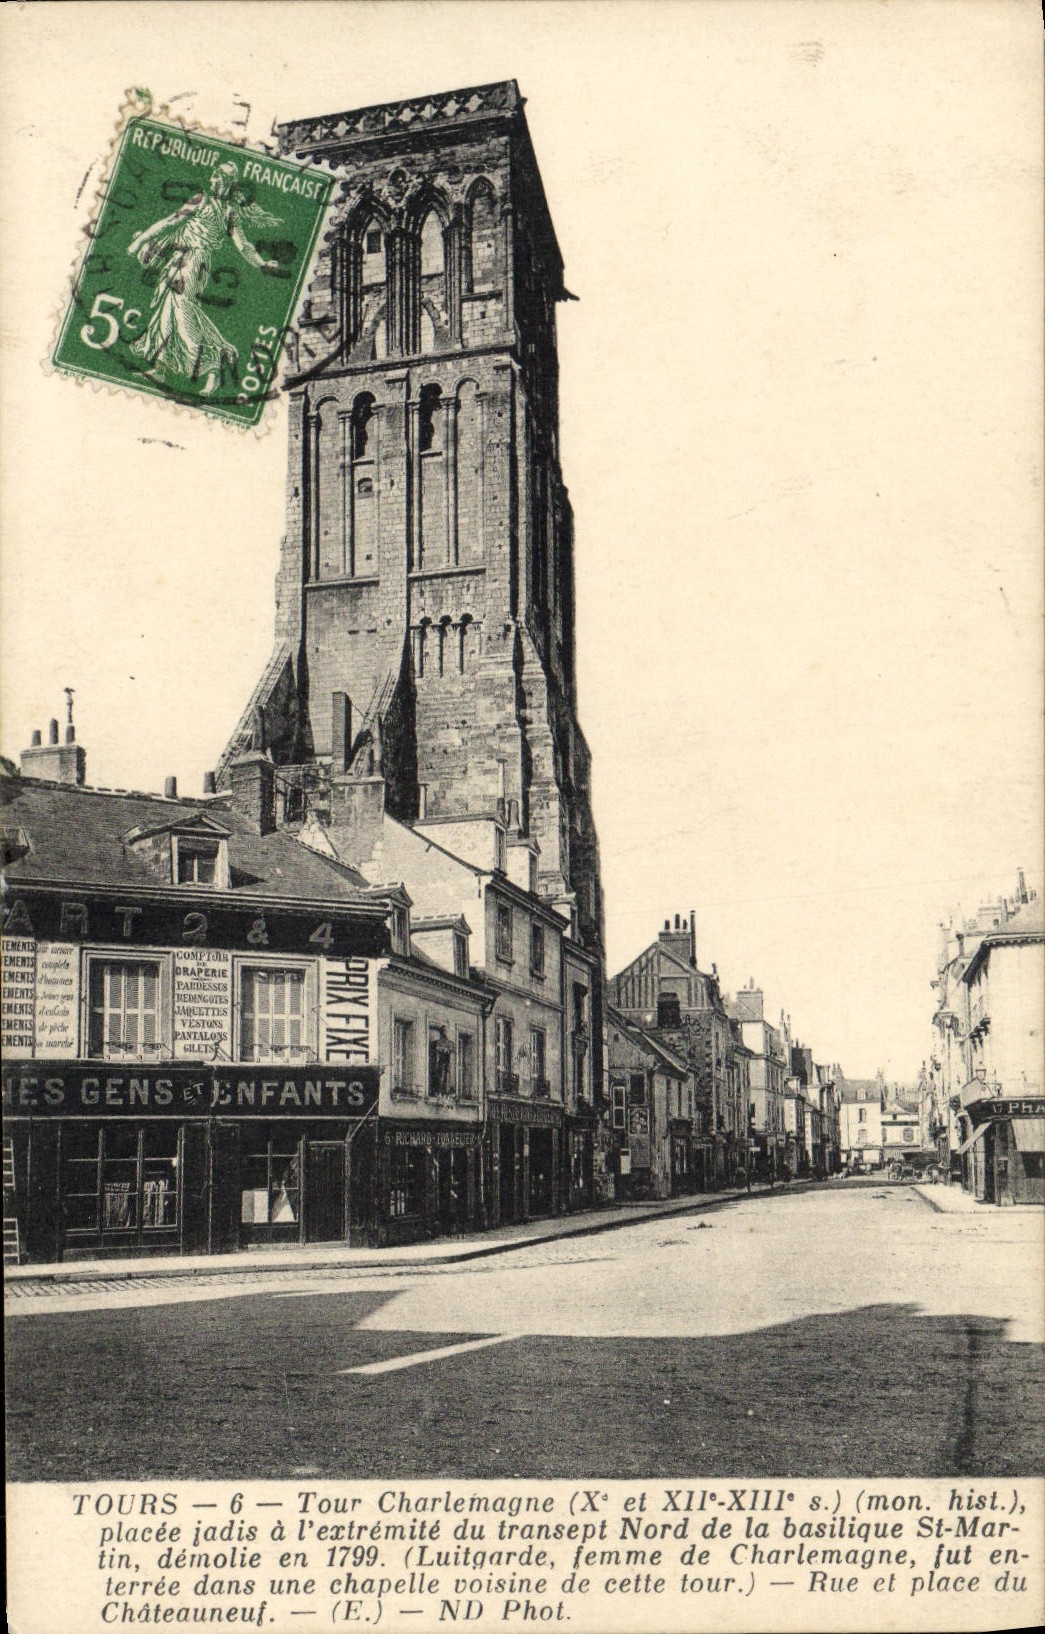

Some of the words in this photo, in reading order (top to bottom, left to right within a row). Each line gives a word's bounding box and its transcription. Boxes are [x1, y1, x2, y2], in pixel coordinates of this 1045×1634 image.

[182, 912, 208, 940] 2
[247, 915, 270, 945] &
[309, 922, 335, 949] 4
[176, 951, 229, 962] COMPTOIR
[175, 967, 228, 978] DRAPERIE
[176, 981, 228, 992] PARDESSUS
[326, 957, 369, 1007] PRIX
[176, 993, 229, 1005] REDINGOTES
[174, 1005, 228, 1017] JAQUETTES
[181, 1018, 223, 1029] VESTONS
[174, 1031, 228, 1041] PANTALONS
[326, 1013, 369, 1063] FIXE
[183, 1043, 216, 1054] GILETS
[81, 1078, 173, 1105] GENS
[182, 1082, 205, 1102] ET
[211, 1079, 365, 1107] ENFANTS
